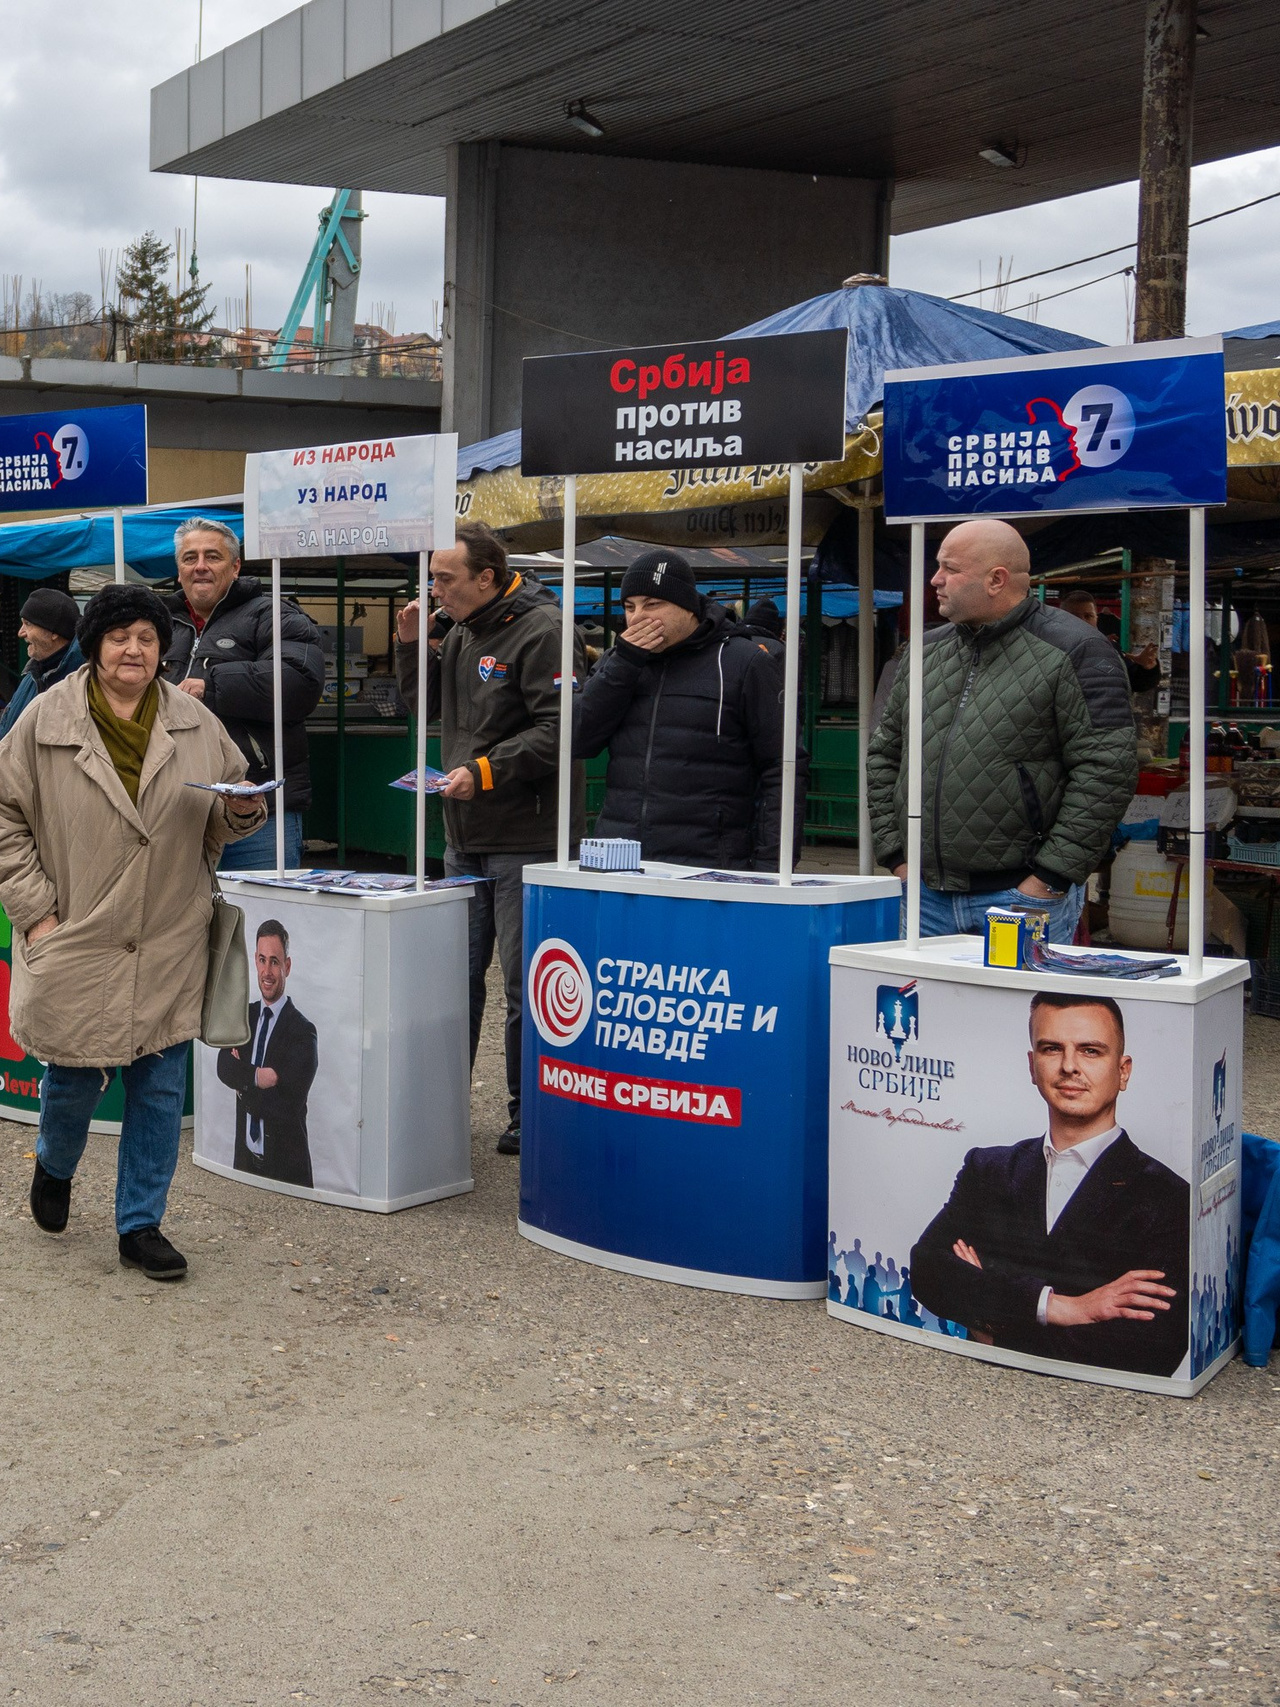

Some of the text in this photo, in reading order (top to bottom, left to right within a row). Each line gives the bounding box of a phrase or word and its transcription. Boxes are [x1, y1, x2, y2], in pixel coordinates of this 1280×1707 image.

[610, 350, 750, 400] Србија
[616, 399, 742, 436] против
[1081, 402, 1121, 452] 7.
[1225, 393, 1280, 443] ivo
[61, 436, 83, 469] 7.
[292, 441, 396, 466] ИЗ НАРОДА
[615, 435, 743, 461] насиља
[948, 430, 1051, 452] СРБИЈА
[948, 448, 1051, 470] ПРОТИВ
[297, 482, 388, 504] УЗ НАРОД
[947, 466, 1057, 487] НАСИЉА
[297, 526, 389, 547] ЗА НАРОД
[596, 957, 731, 996] СТРАНКА
[596, 989, 778, 1033] СЛОБОДЕ И
[595, 1020, 709, 1062] ПРАВДЕ
[847, 1044, 956, 1080] НОВО ЛИЦЕ
[543, 1064, 732, 1119] МОЖЕ СРБИЈА
[858, 1067, 941, 1103] СРБИЈЕ
